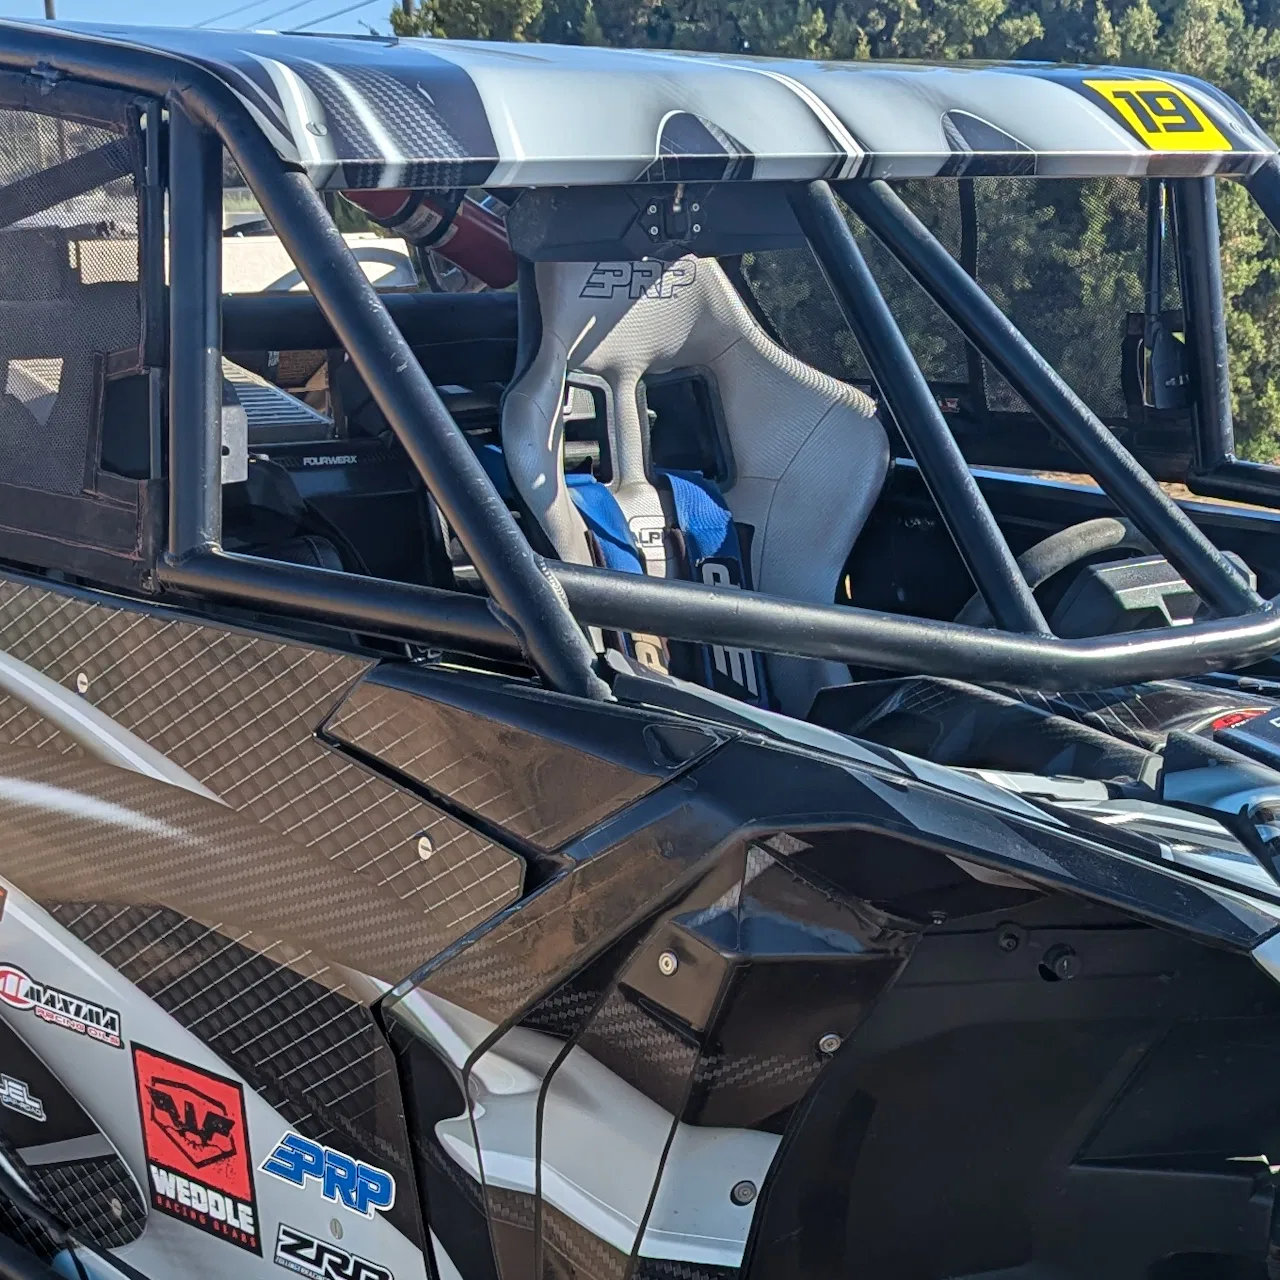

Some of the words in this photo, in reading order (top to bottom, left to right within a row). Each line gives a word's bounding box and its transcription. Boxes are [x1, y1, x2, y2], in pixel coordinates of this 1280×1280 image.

[1112, 90, 1205, 134] 19
[579, 259, 697, 299] PRP
[303, 455, 357, 466] FOURWERX
[22, 983, 120, 1034] MAXIMA
[35, 1005, 86, 1032] RACING
[87, 1026, 120, 1047] OILS
[262, 1132, 394, 1215] PRP
[149, 1163, 256, 1236] WEDDLE
[157, 1195, 207, 1225] RACING
[213, 1221, 257, 1248] GEARS
